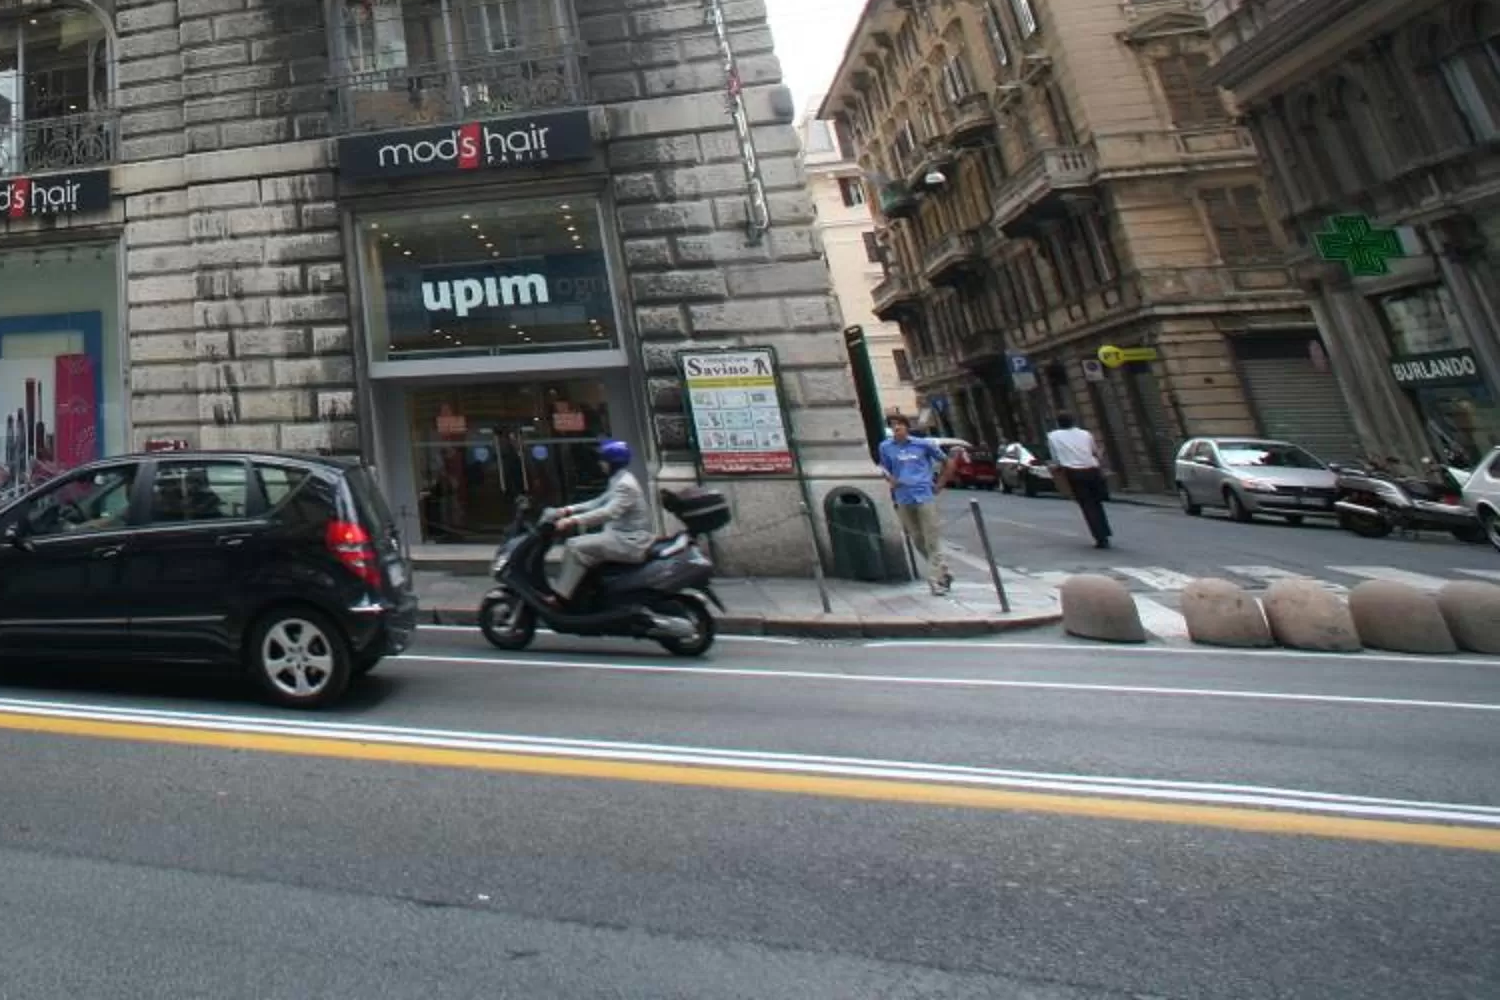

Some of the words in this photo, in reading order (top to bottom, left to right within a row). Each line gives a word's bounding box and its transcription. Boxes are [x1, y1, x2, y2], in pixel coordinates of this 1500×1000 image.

[379, 129, 477, 167] mod's
[483, 123, 549, 155] hair
[31, 180, 81, 208] hair
[421, 273, 550, 317] upim
[687, 358, 749, 377] Savino
[1391, 356, 1477, 381] BURLANDO
